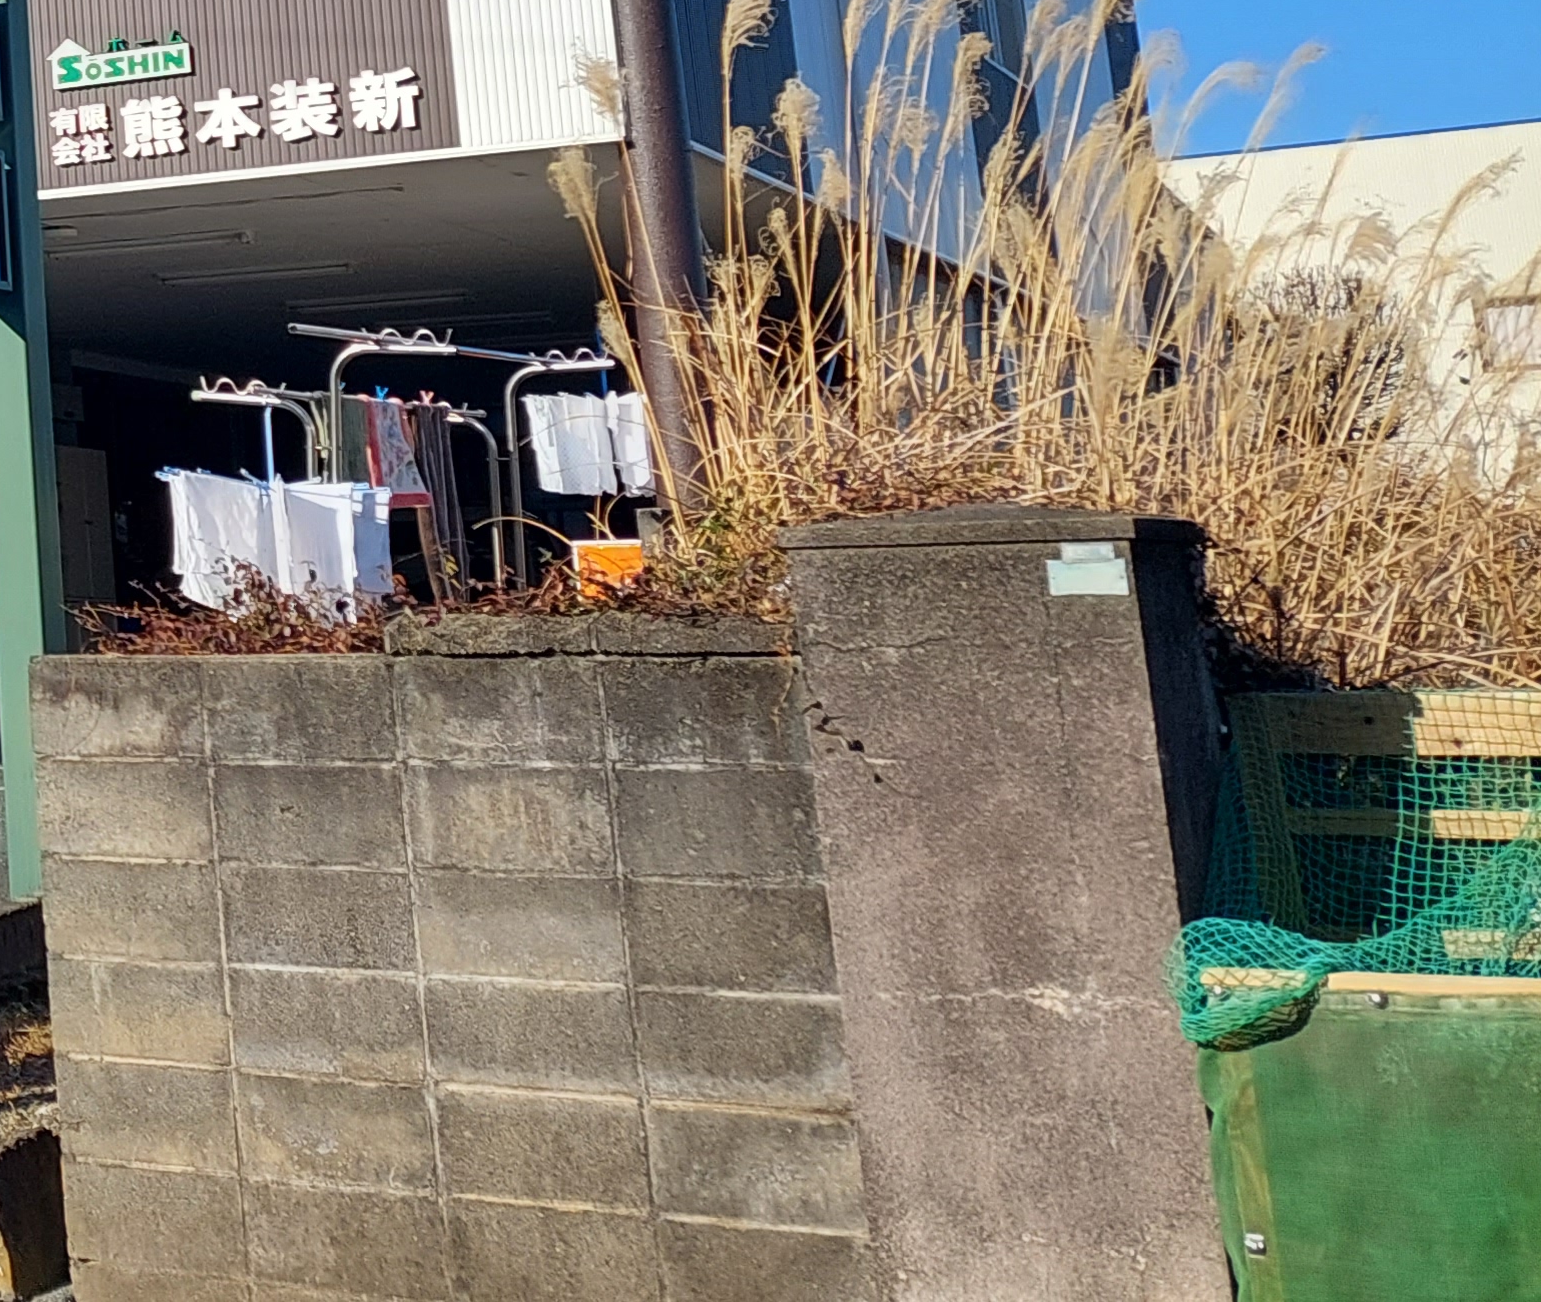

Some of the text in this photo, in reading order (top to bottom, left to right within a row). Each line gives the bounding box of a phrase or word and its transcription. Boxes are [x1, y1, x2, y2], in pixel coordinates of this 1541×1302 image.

[49, 102, 110, 137] 有限
[119, 66, 420, 160] 熊本装新
[50, 134, 113, 167] 会社
